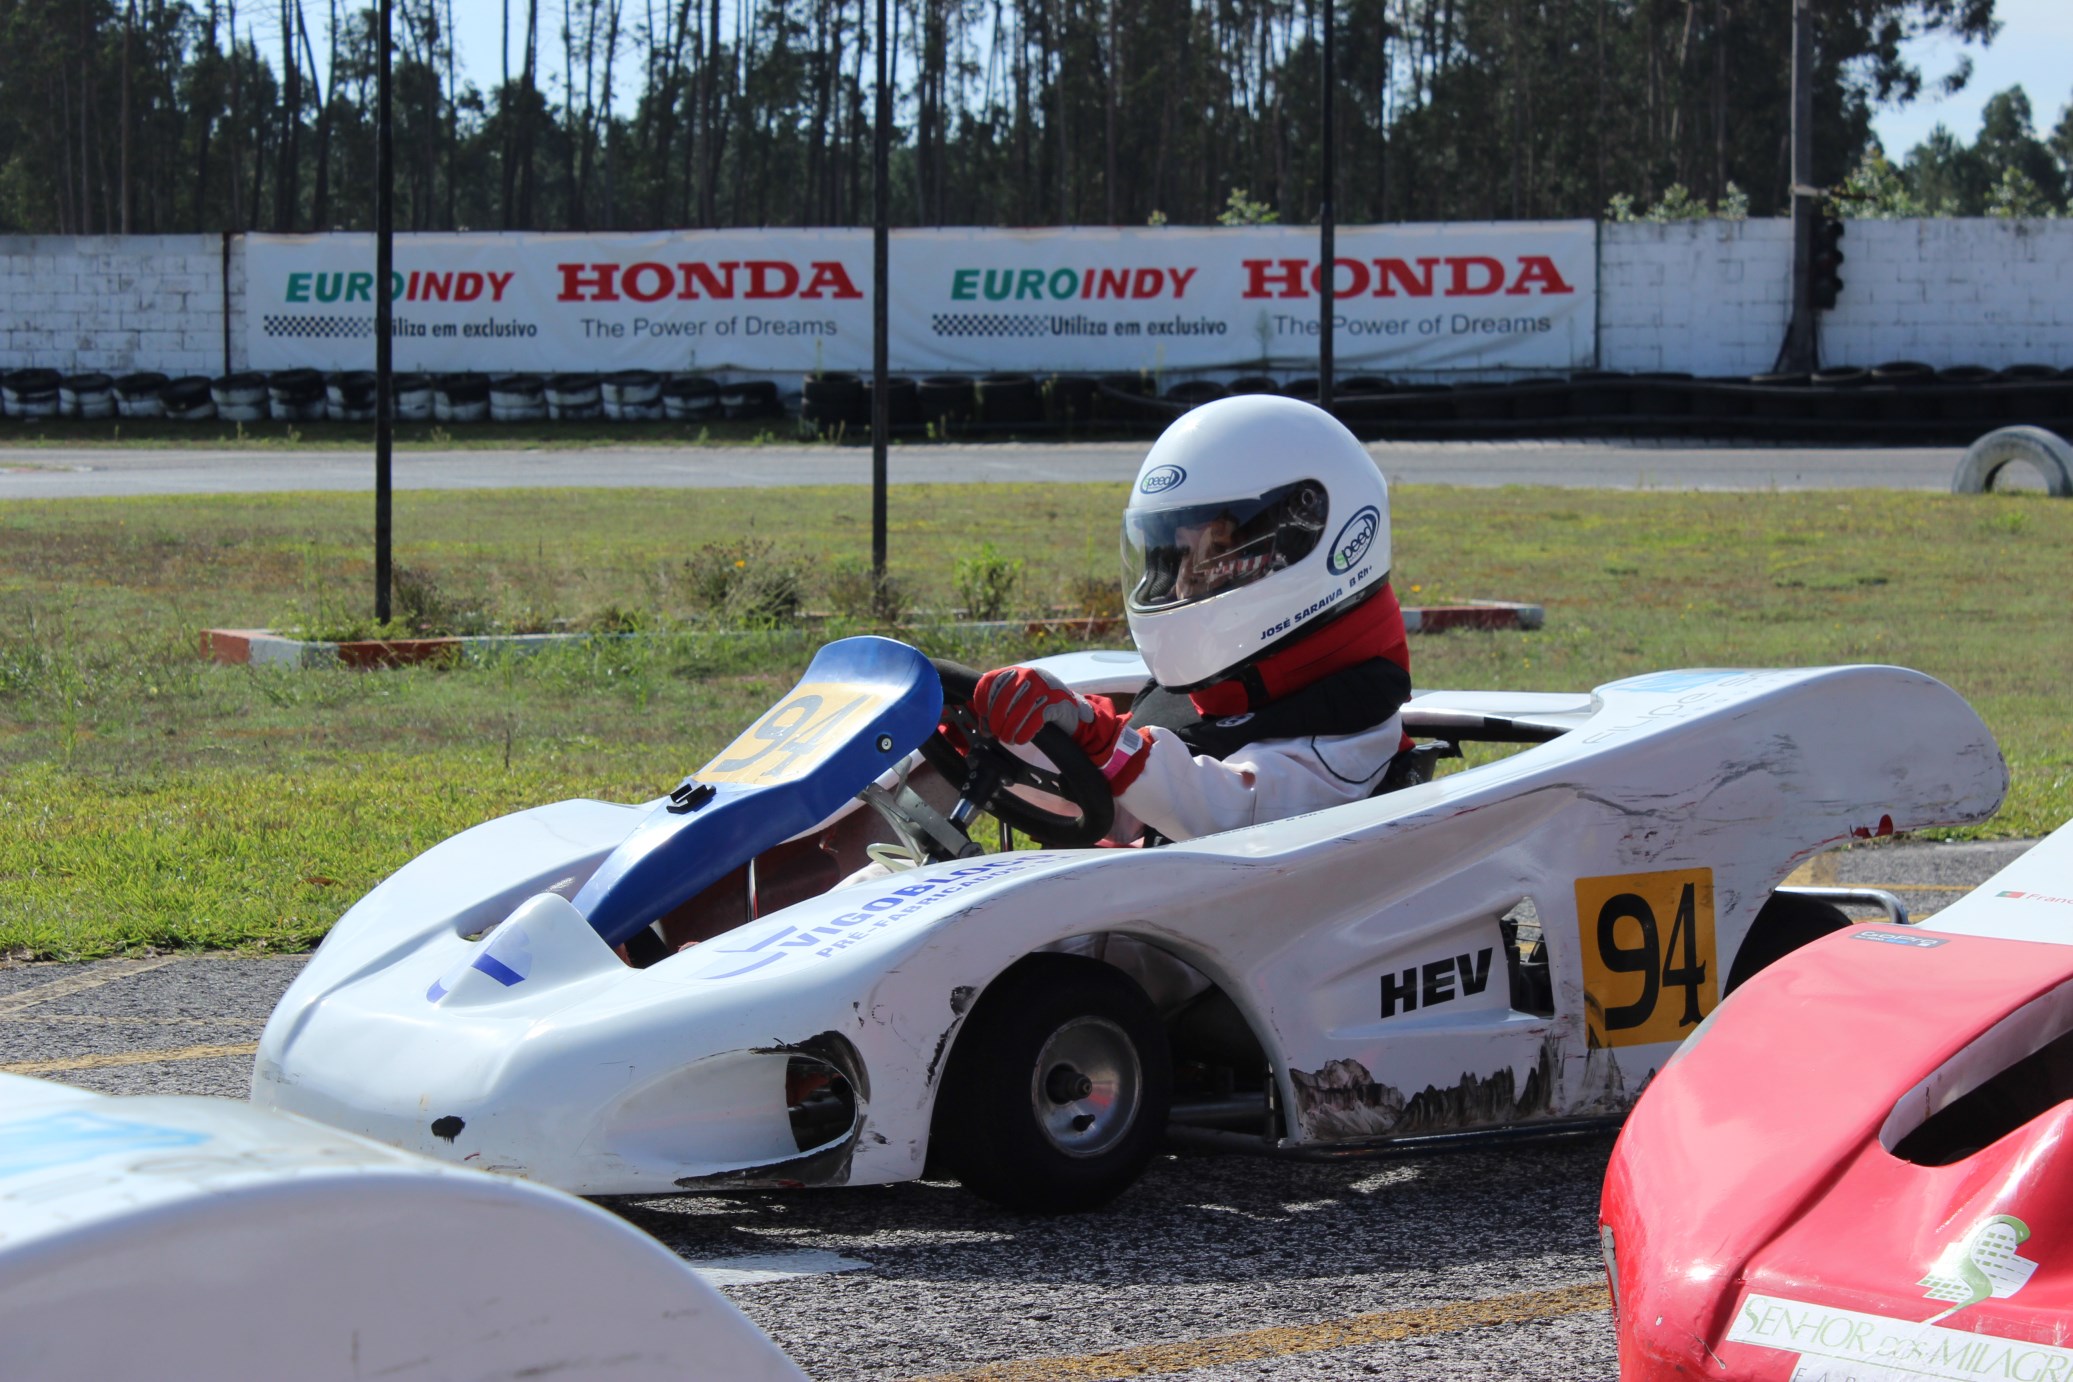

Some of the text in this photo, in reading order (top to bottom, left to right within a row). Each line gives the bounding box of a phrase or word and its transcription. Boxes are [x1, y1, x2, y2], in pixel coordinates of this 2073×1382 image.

[557, 261, 864, 302] HONDA
[952, 268, 1197, 301] EUROINDY
[1242, 255, 1574, 300] HONDA
[432, 322, 457, 338] em
[463, 317, 538, 338] exclusivo
[580, 315, 838, 339] The Power of Dreams
[1051, 315, 1228, 337] Utiliza em exclusivo
[1273, 314, 1551, 336] The Power of Dreams
[1334, 517, 1373, 567] speed
[1260, 618, 1291, 640] JOSÉ
[1294, 588, 1344, 623] SARAIVA
[1349, 577, 1357, 588] B
[711, 694, 873, 778] 94
[1597, 882, 1706, 1031] 94
[1861, 930, 1938, 945] GoPro
[1380, 947, 1493, 1019] HEV
[1744, 1297, 1875, 1352] SENHOR
[1928, 1336, 2073, 1382] MILAGR
